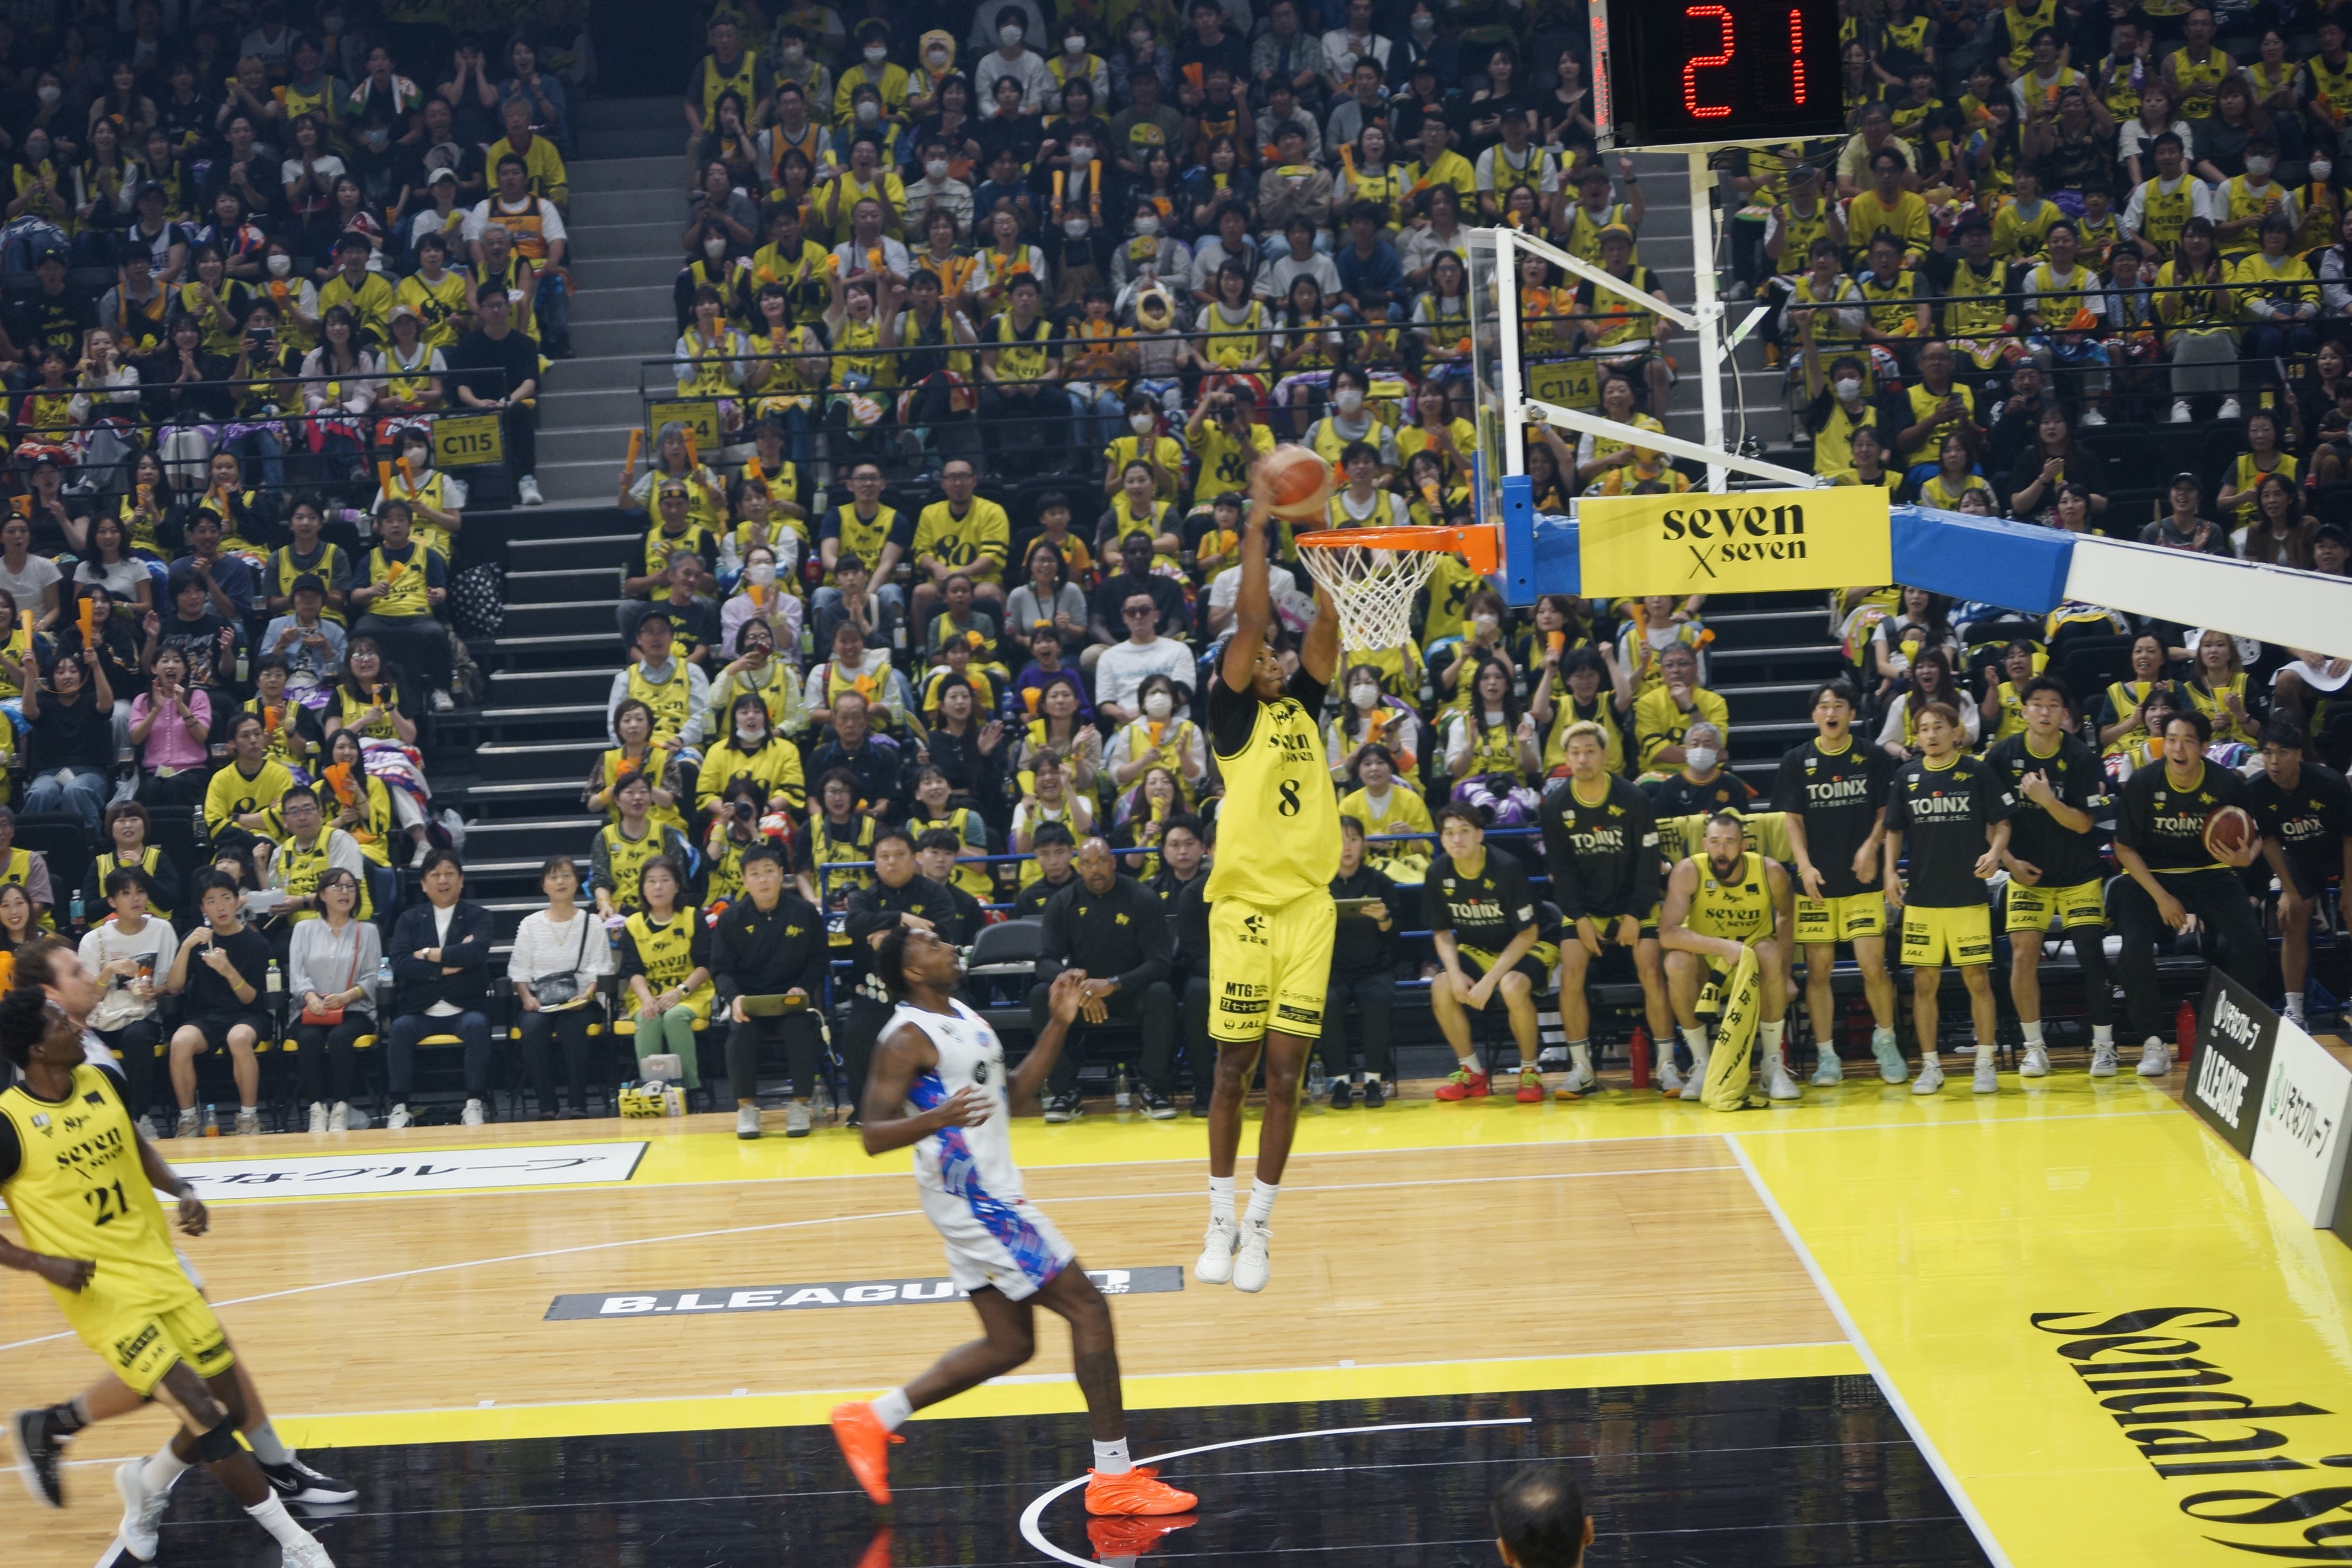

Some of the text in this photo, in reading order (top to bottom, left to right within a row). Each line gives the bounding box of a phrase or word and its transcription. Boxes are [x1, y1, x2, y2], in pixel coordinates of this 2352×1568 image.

[1684, 5, 1806, 117] 21
[1540, 377, 1590, 399] C114
[443, 433, 493, 454] C115
[1662, 504, 1807, 540] seven
[1721, 540, 1808, 562] seven
[1279, 779, 1301, 816] 8
[1705, 908, 1760, 920] seven
[1226, 981, 1252, 997] MTG
[1237, 1019, 1261, 1029] JAL
[2278, 1078, 2333, 1159] りそなグループ
[56, 1126, 121, 1170] seven
[84, 1178, 129, 1226] 21
[599, 1281, 970, 1314] B.LEAGU
